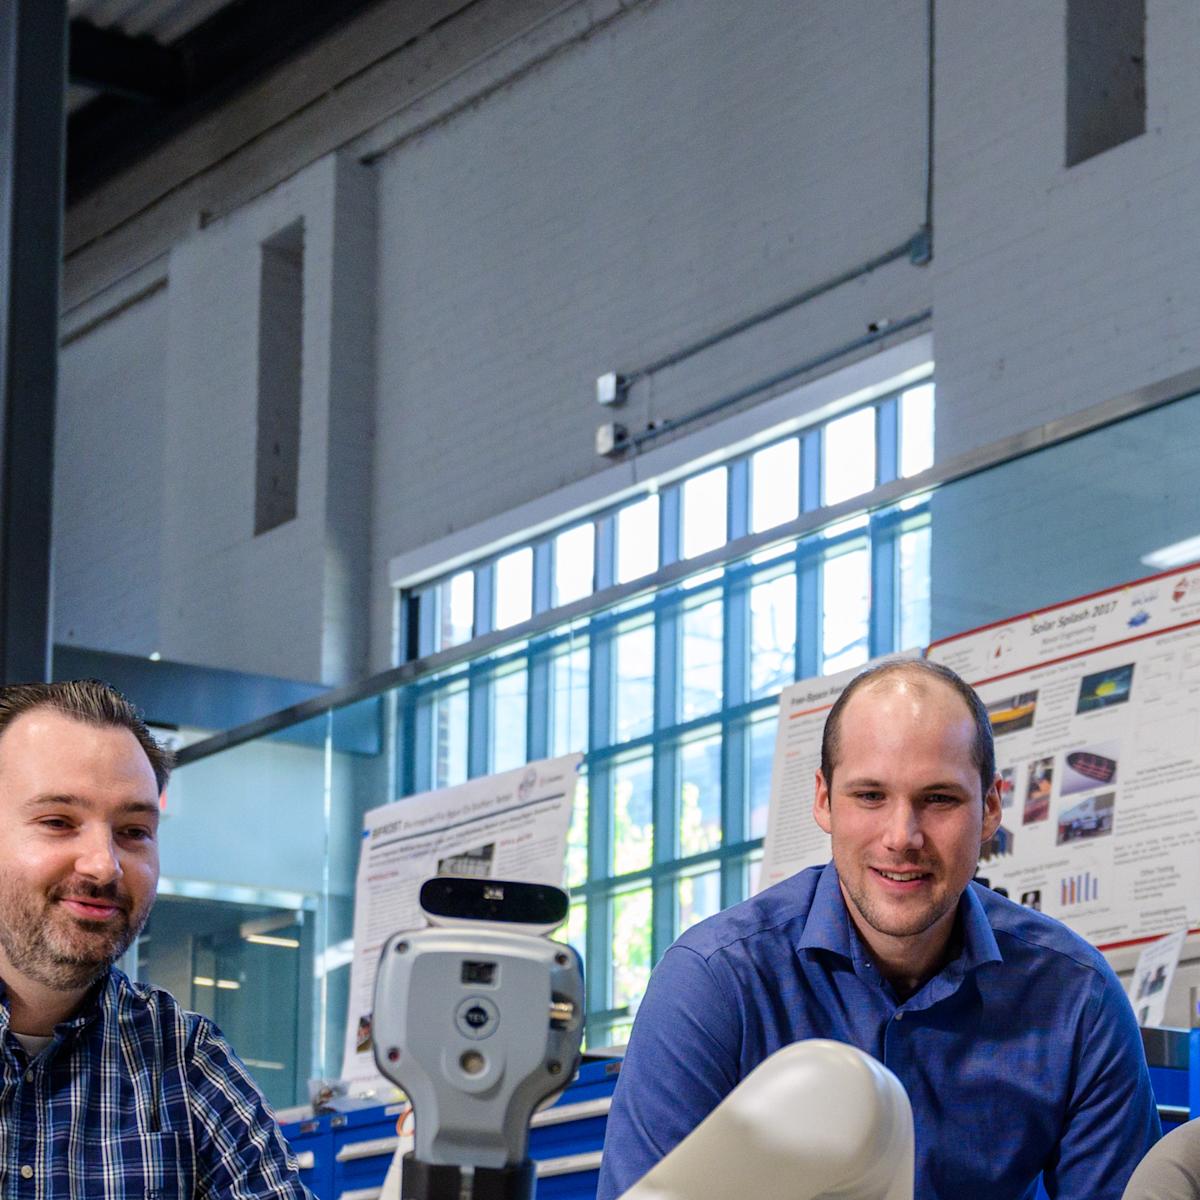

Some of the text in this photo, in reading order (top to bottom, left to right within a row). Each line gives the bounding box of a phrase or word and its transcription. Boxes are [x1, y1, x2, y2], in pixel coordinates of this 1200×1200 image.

[1029, 599, 1119, 636] Solar Splash 2017
